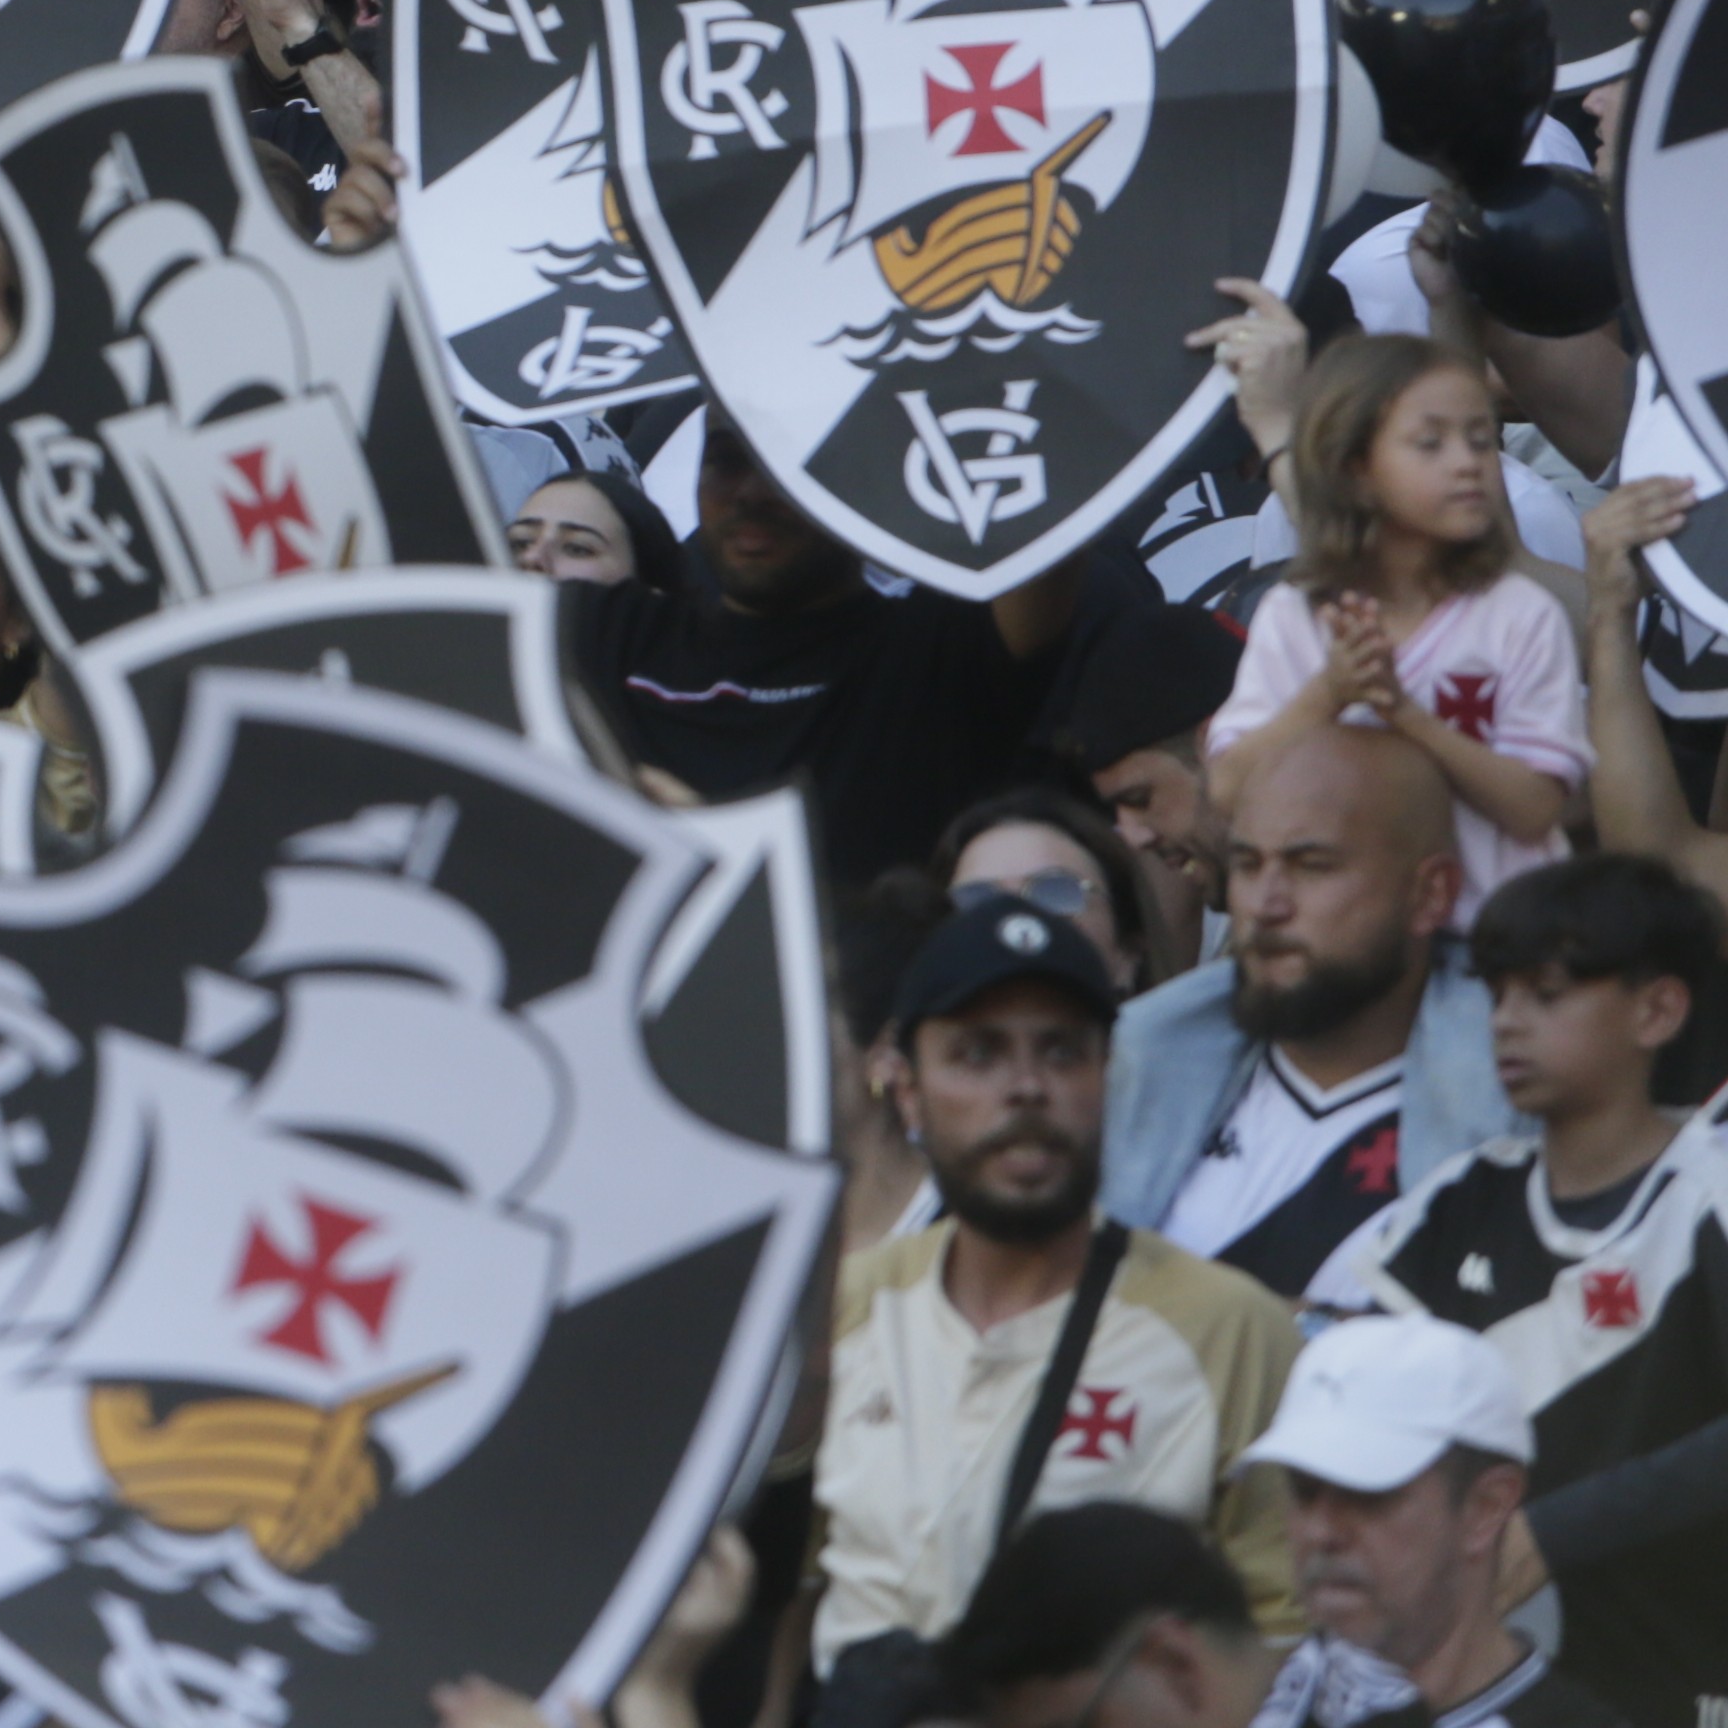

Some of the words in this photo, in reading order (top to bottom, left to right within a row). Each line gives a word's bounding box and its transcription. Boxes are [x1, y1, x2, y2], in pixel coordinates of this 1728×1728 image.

[518, 302, 673, 400] VG
[8, 413, 150, 599] CR
[896, 379, 1048, 547] VG
